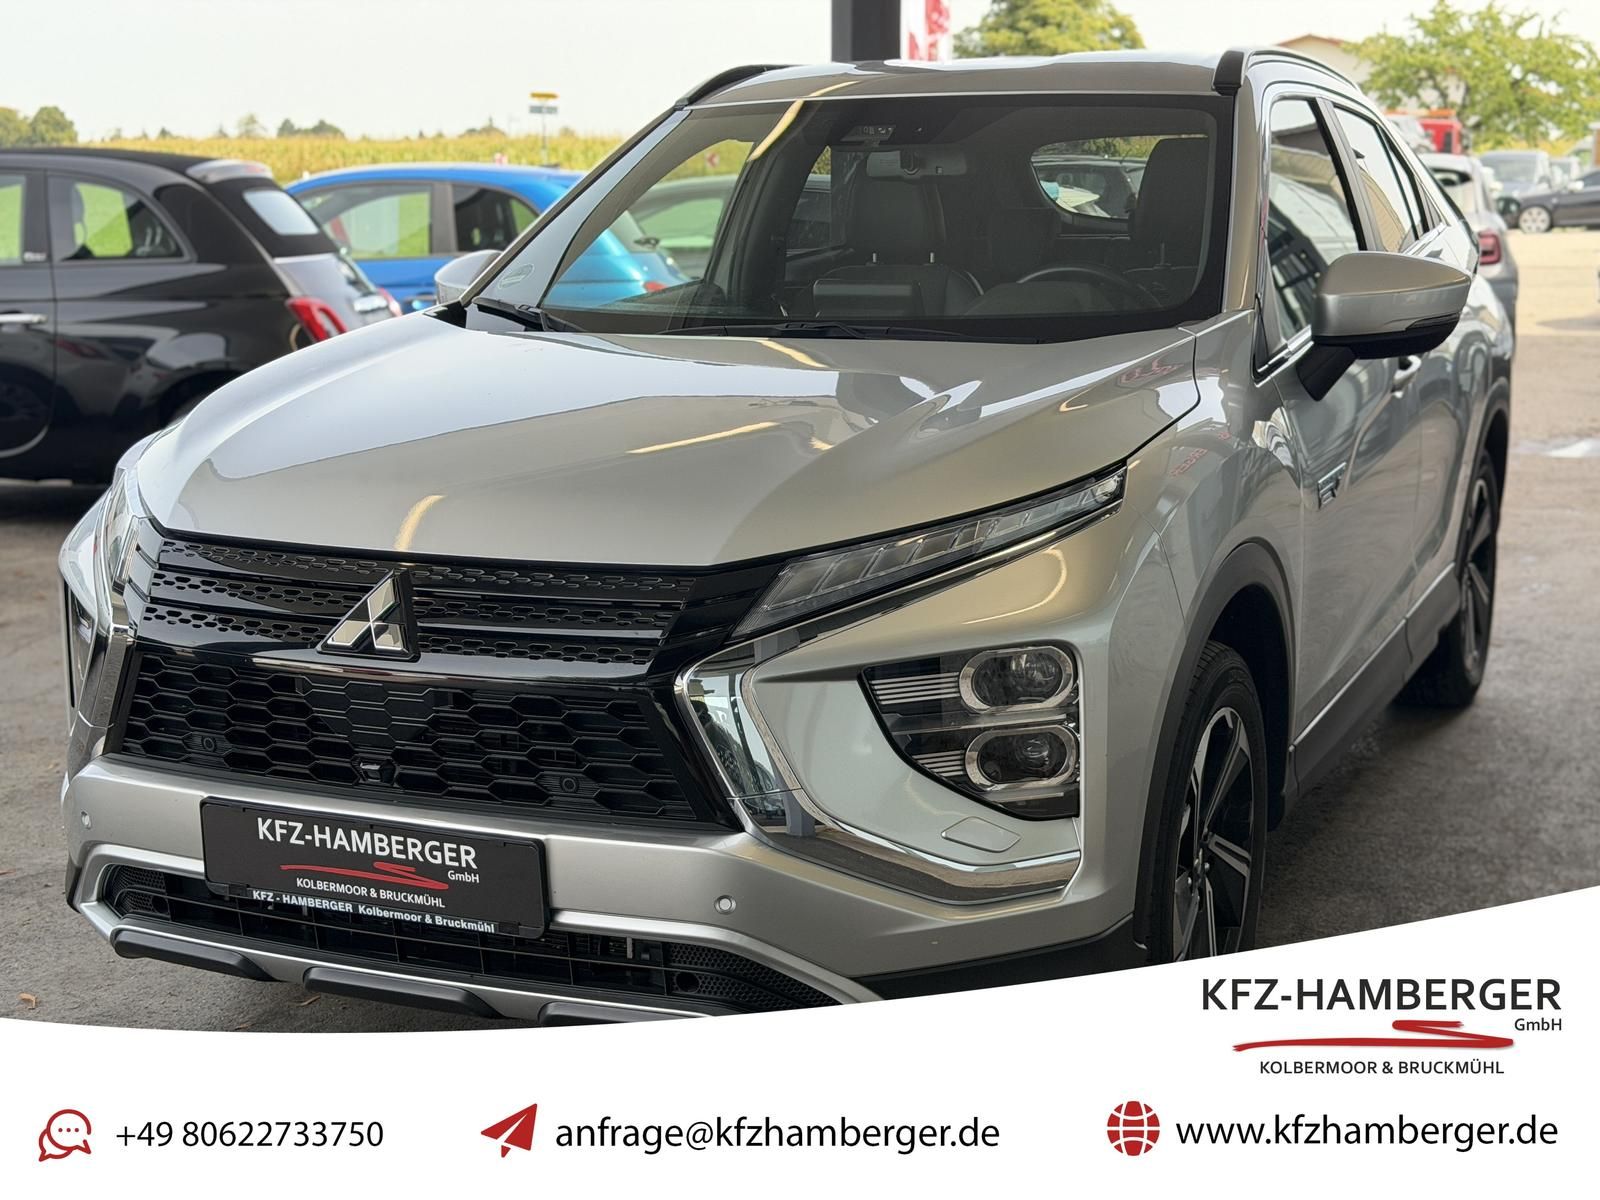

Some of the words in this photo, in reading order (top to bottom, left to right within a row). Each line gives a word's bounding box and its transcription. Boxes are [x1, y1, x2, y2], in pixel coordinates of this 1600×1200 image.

[257, 817, 478, 870] KFZ-HAMBERGER
[296, 877, 368, 897] KOLBERMOOR
[369, 888, 378, 898] &
[379, 889, 446, 908] BRUCKMÜHL
[447, 870, 480, 884] GmbH
[252, 890, 274, 902] KFZ
[282, 894, 353, 913] HAMBERGER
[358, 904, 422, 923] Kolbermoor
[425, 914, 433, 924] &
[434, 915, 496, 934] Bruckmühl
